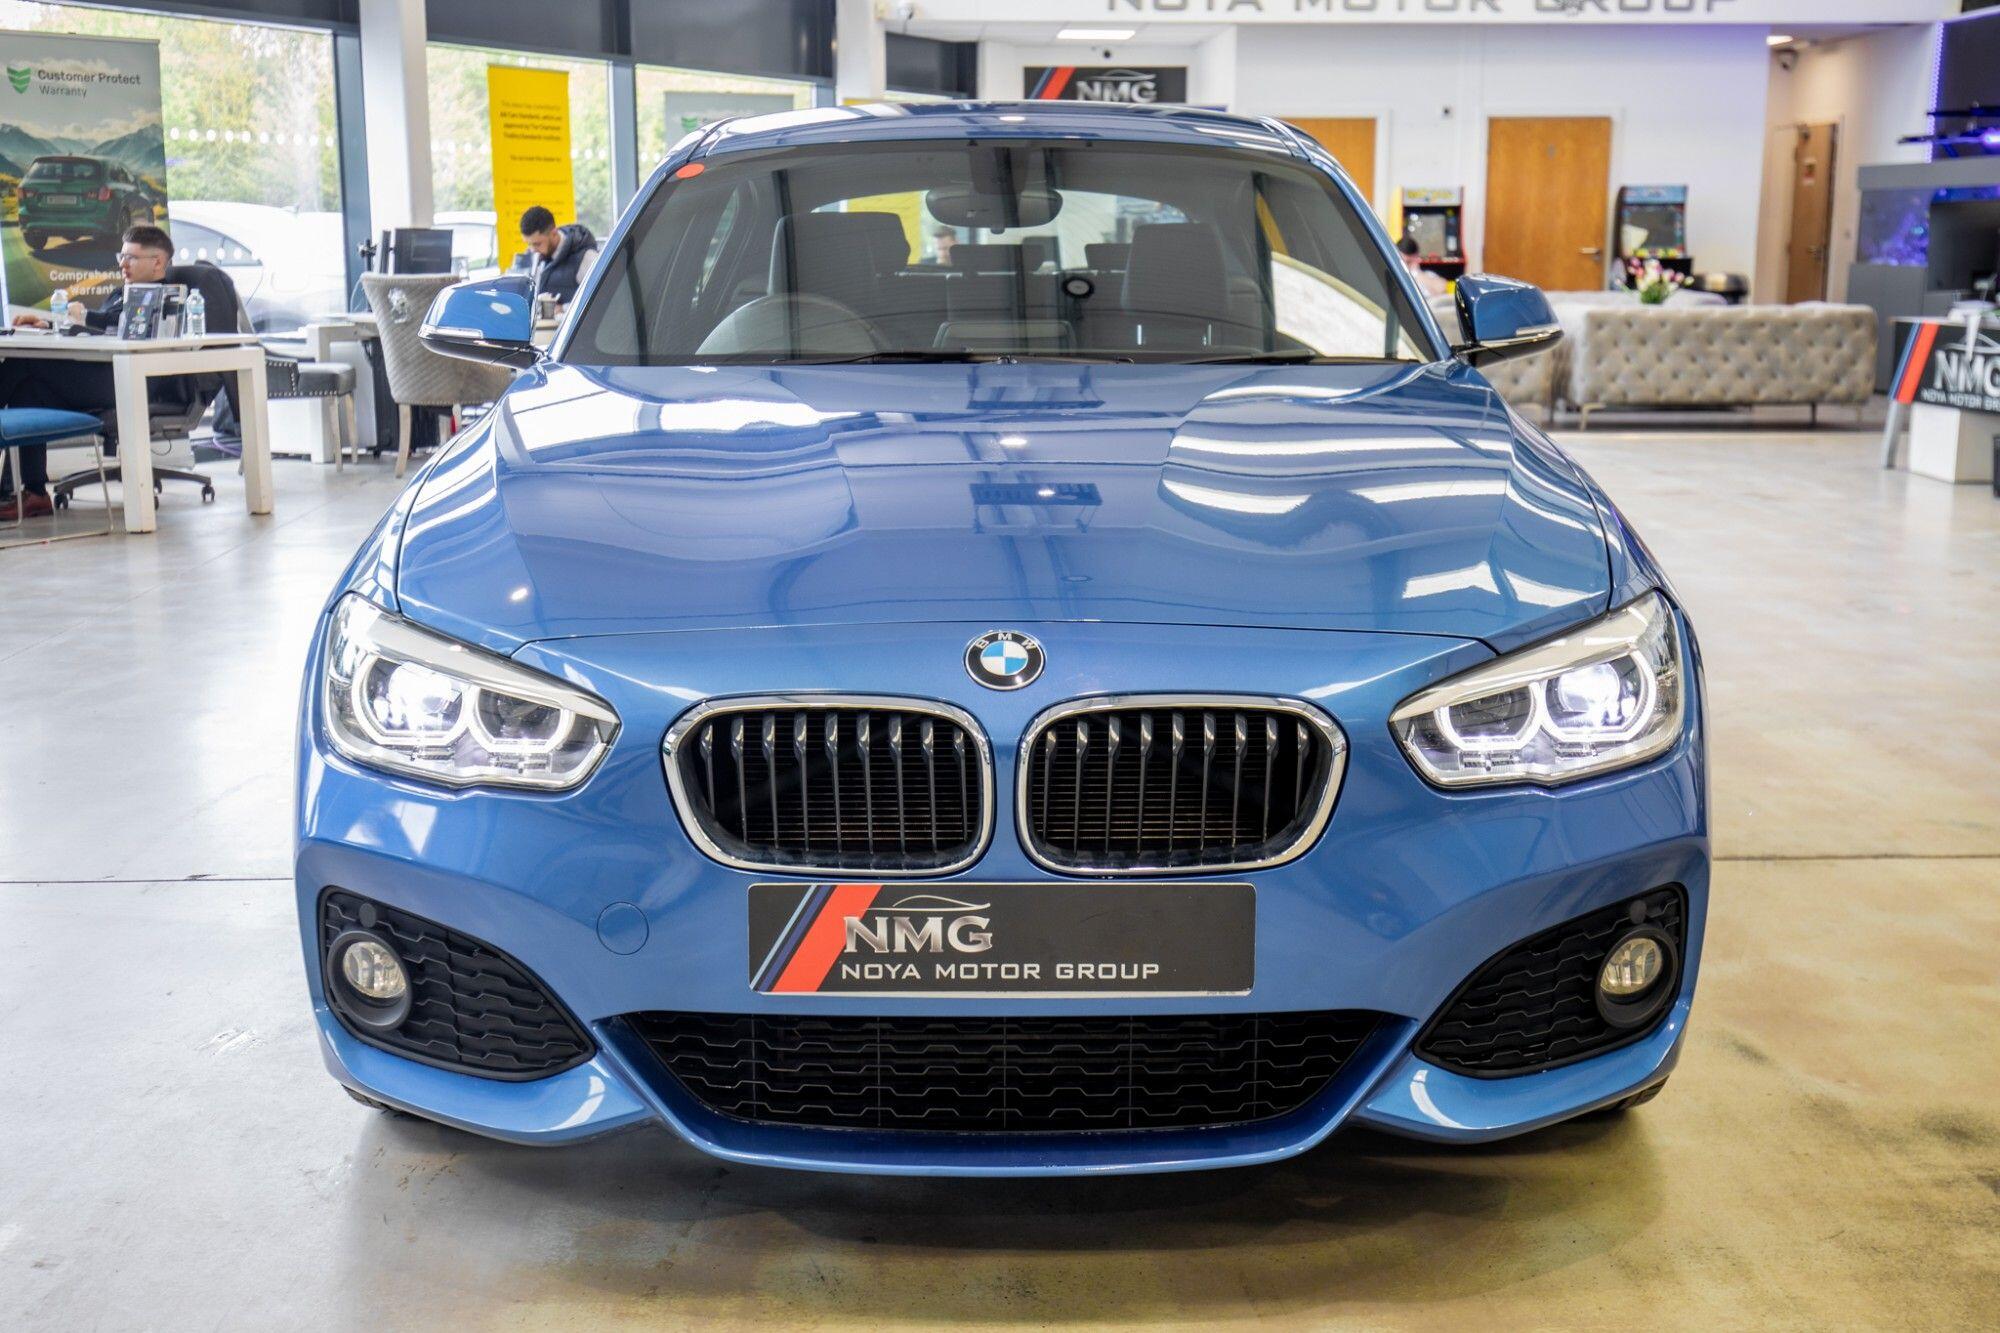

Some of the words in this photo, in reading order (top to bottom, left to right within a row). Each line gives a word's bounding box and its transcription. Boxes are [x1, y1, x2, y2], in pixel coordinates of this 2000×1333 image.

[38, 69, 95, 83] Customer
[98, 73, 142, 85] Protect
[39, 85, 87, 98] Warranty
[1075, 80, 1157, 103] NMG
[49, 269, 123, 282] Comprehens
[69, 284, 116, 295] Warrant
[975, 632, 1037, 650] BMW
[843, 915, 993, 953] NMG
[841, 963, 921, 980] NOYA
[935, 963, 1041, 980] MOTOR
[1055, 963, 1161, 980] GROUP
